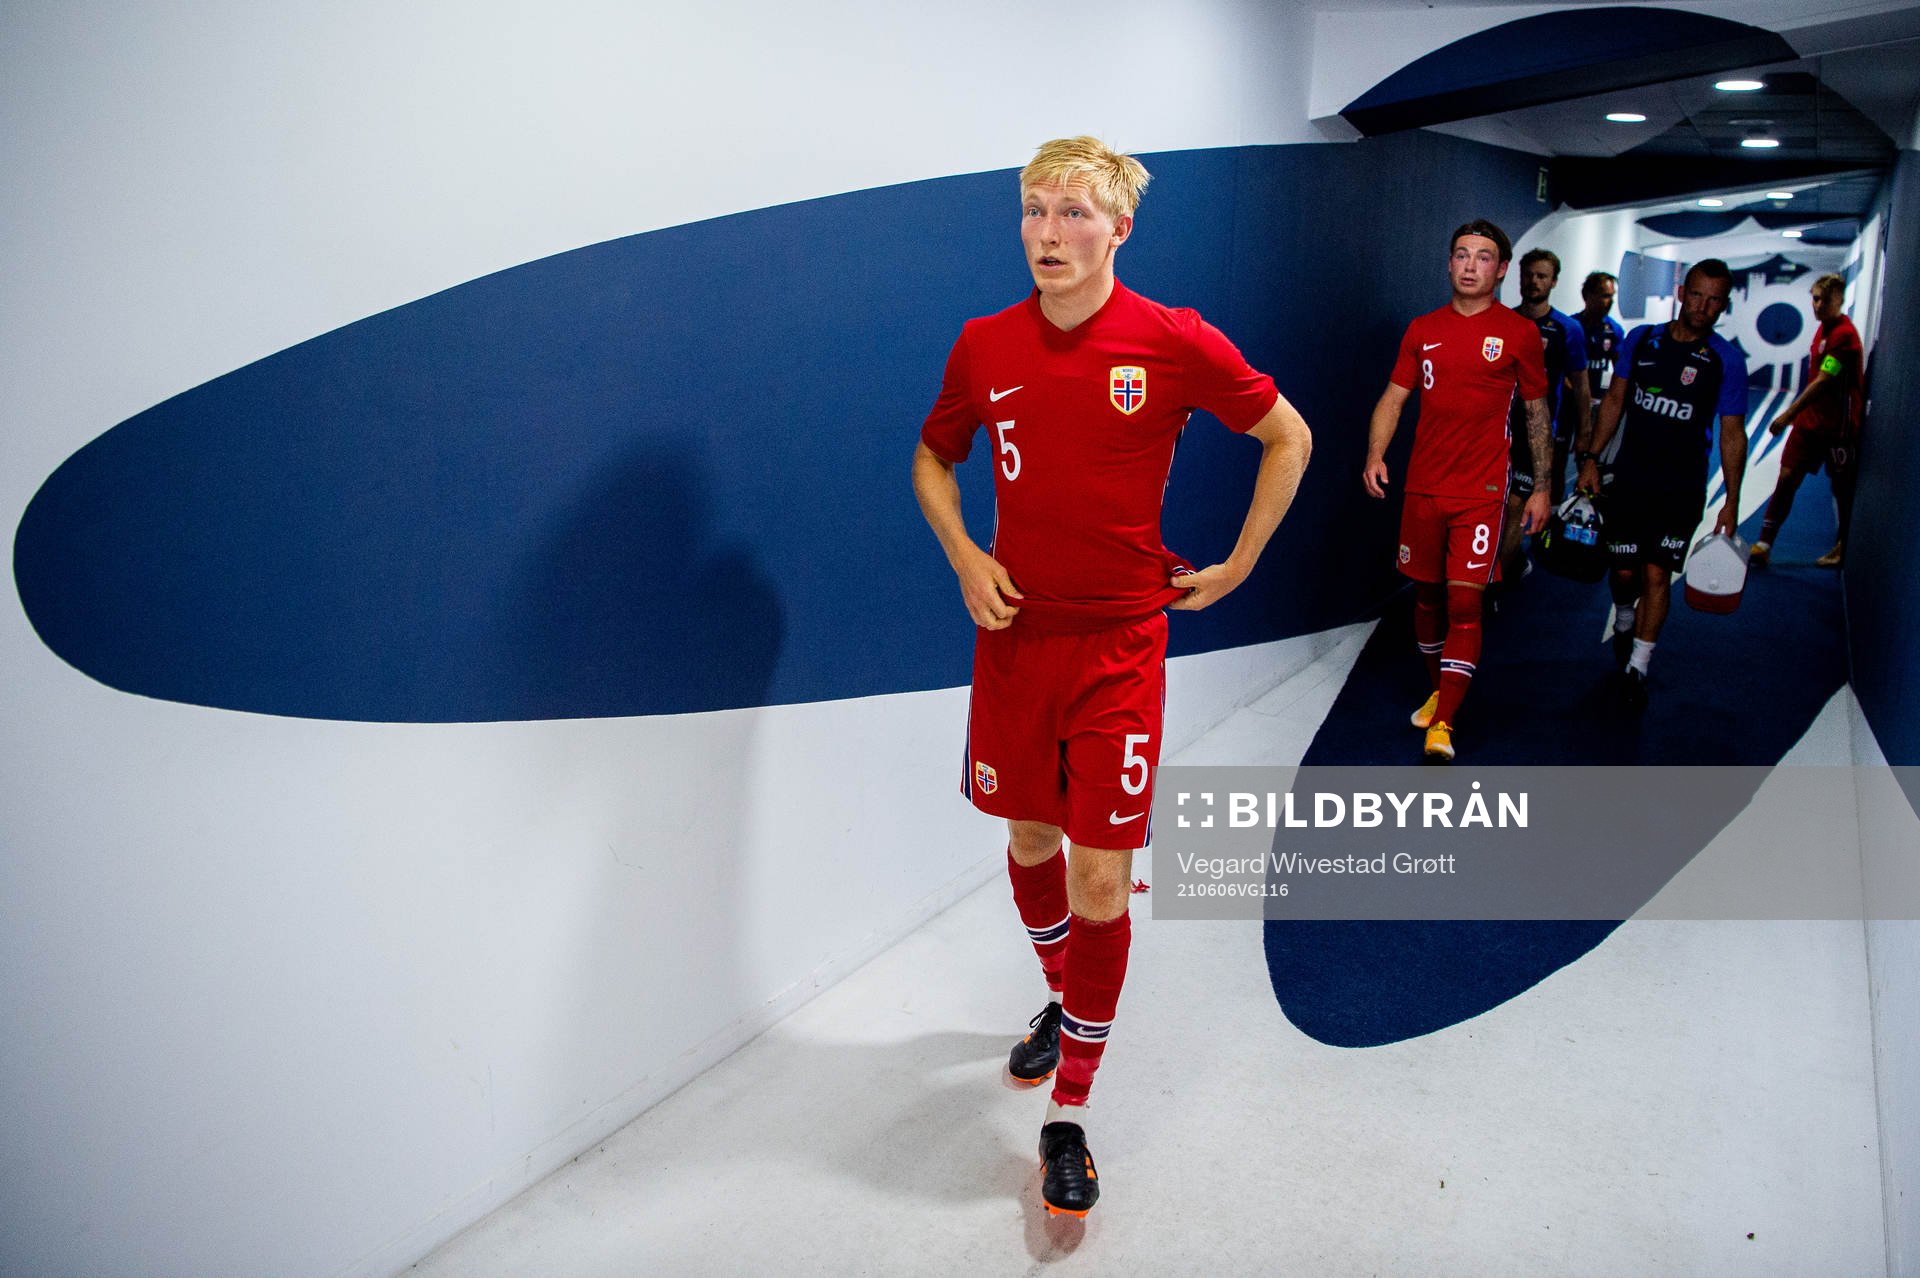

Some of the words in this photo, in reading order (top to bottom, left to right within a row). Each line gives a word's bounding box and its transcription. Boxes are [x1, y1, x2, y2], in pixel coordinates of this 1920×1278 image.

[1422, 359, 1435, 389] 8
[1634, 381, 1695, 421] bama
[996, 420, 1021, 481] 5
[1472, 524, 1490, 555] 8
[1121, 734, 1150, 796] 5
